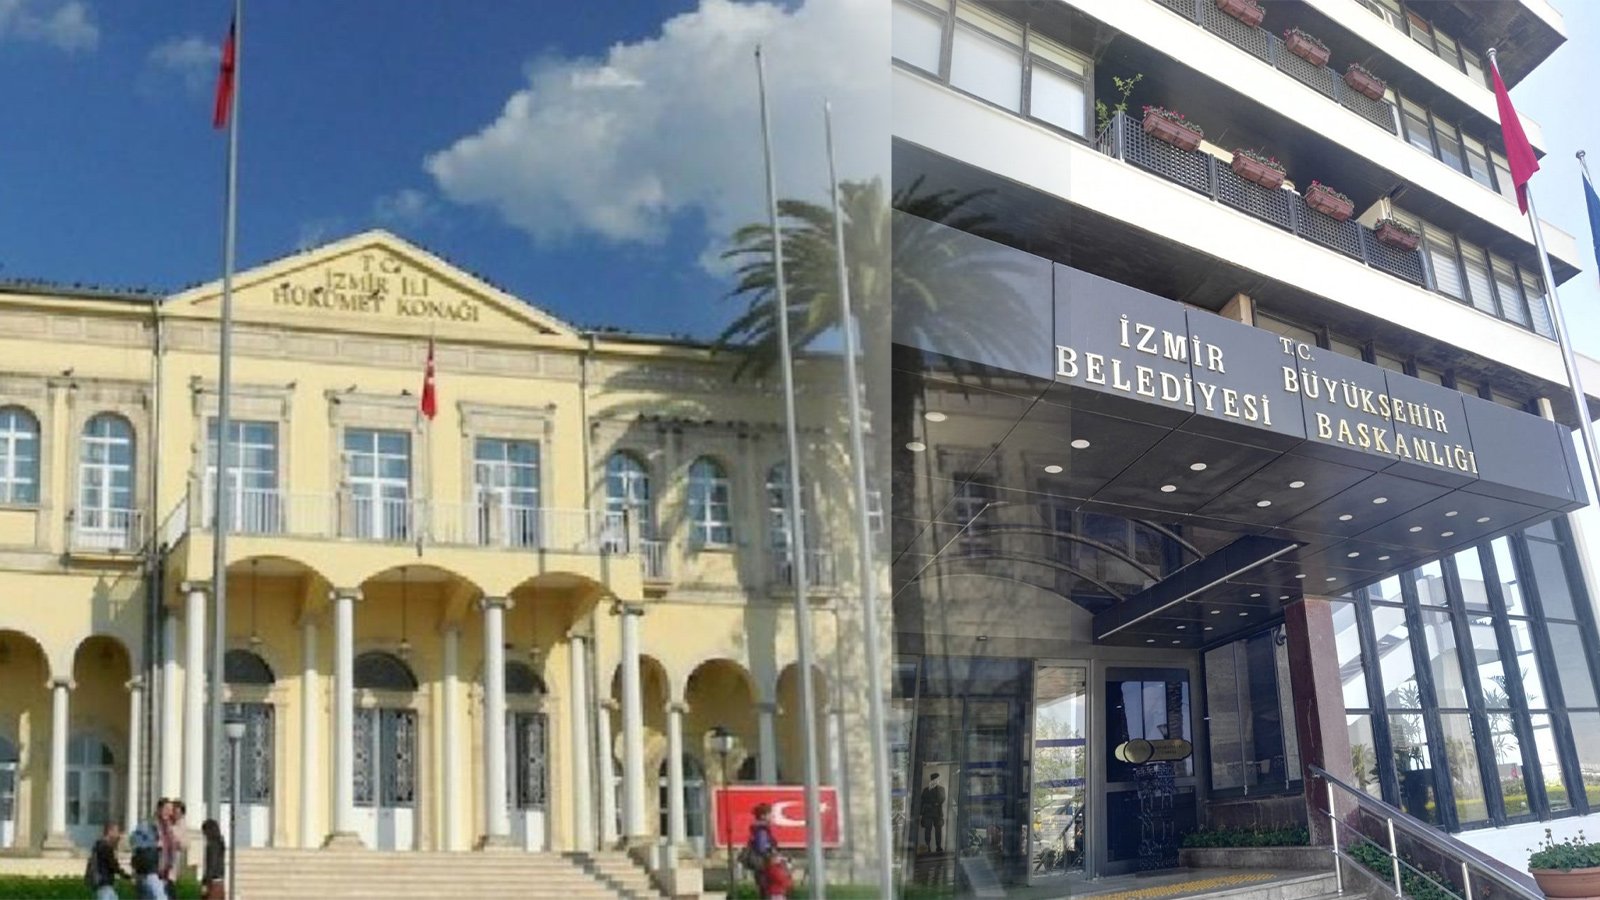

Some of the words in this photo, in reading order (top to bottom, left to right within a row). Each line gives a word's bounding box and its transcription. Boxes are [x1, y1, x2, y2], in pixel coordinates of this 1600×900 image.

[1120, 313, 1226, 374] İZMİR
[1279, 336, 1316, 361] T.C.
[1055, 344, 1272, 425] BELEDİYESİ
[1282, 366, 1448, 434] BÜYÜKŞEHİR
[1315, 411, 1478, 474] BAŞKANLIĞI
